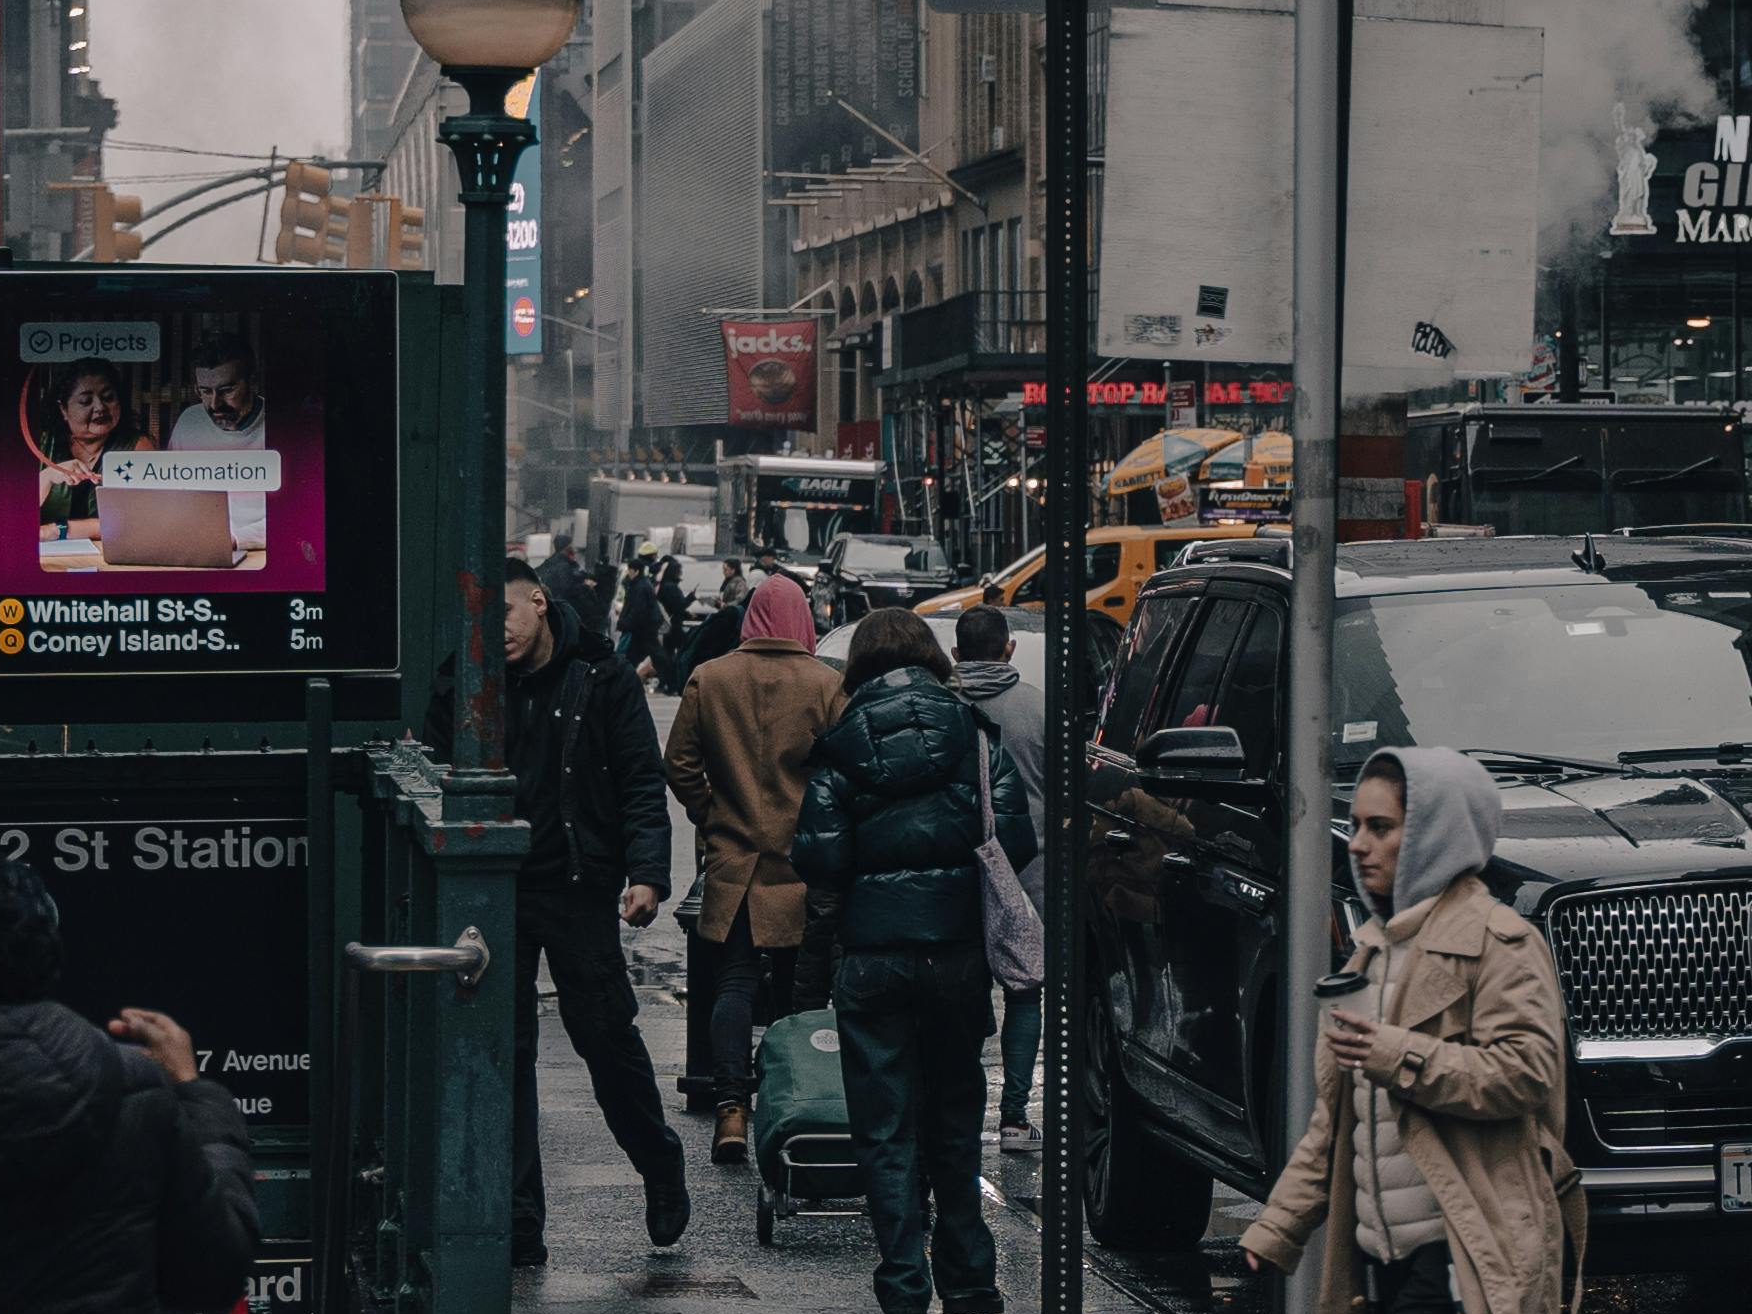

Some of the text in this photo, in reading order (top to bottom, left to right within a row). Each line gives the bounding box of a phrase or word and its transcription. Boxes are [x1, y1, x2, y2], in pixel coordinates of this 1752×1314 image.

[898, 42, 914, 97] SCHOOL
[59, 333, 147, 356] Projects
[727, 328, 812, 358] jacks.
[142, 462, 267, 482] Automation
[799, 478, 852, 490] EAGLE
[2, 604, 18, 619] W
[27, 599, 149, 624] Whitehall
[157, 599, 227, 623] St-S..
[5, 635, 17, 649] Q
[28, 630, 112, 657] Coney
[119, 628, 240, 652] Island-S..
[53, 828, 110, 871] St
[132, 826, 309, 870] Station
[196, 1050, 310, 1073] 7 Avenue
